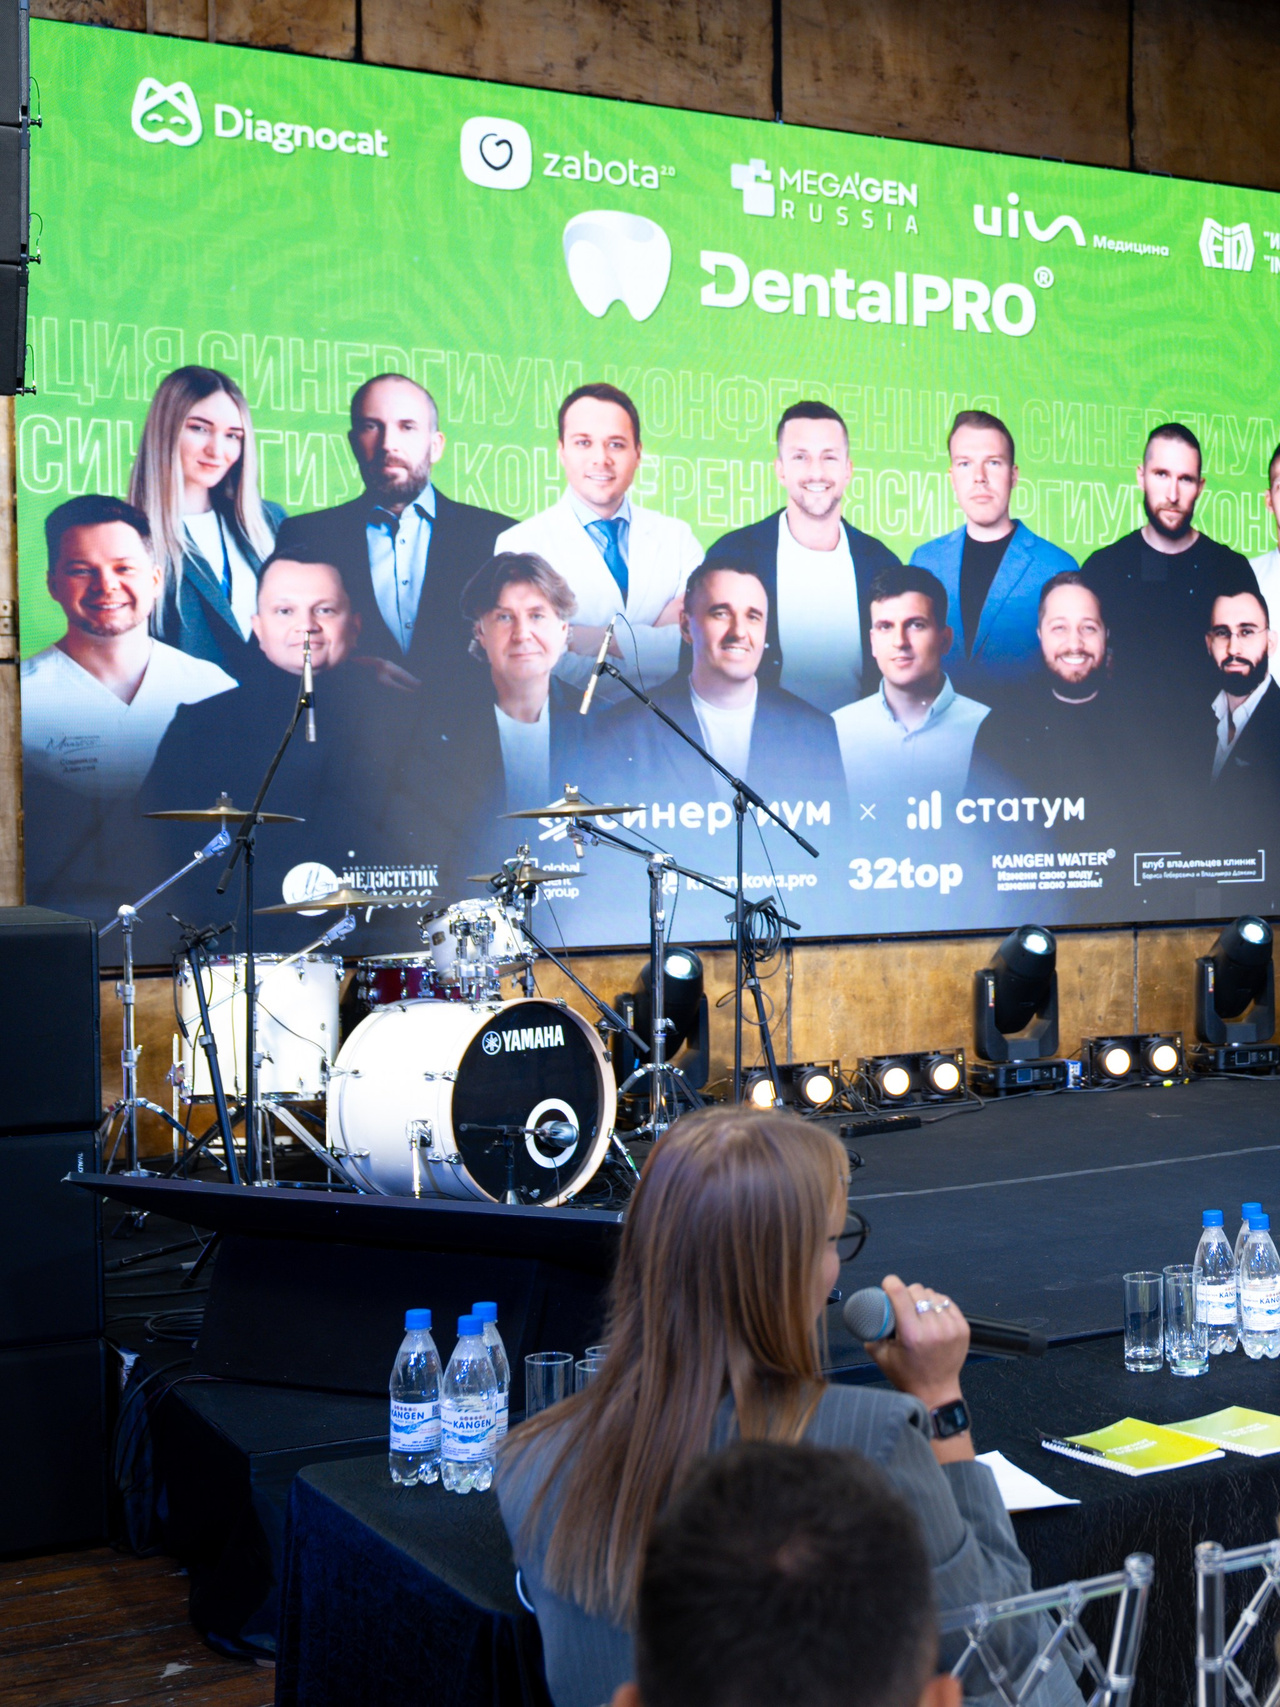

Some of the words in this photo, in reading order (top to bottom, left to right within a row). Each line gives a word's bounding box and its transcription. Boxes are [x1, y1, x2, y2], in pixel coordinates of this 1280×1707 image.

[214, 103, 389, 159] Diagnocat
[781, 199, 919, 235] RUSSIA
[1092, 234, 1170, 257] Медицина
[595, 800, 831, 836] синериум
[956, 796, 1086, 829] статум
[992, 853, 1055, 869] KANGEN
[1142, 858, 1164, 871] клуб
[1166, 859, 1222, 869] владельцев
[1223, 858, 1256, 866] клиник
[848, 857, 964, 894] 32top
[543, 887, 580, 901] group
[501, 1024, 565, 1052] YAMAHA
[391, 1409, 425, 1421] KANGEN
[453, 1418, 492, 1430] KANGEN
